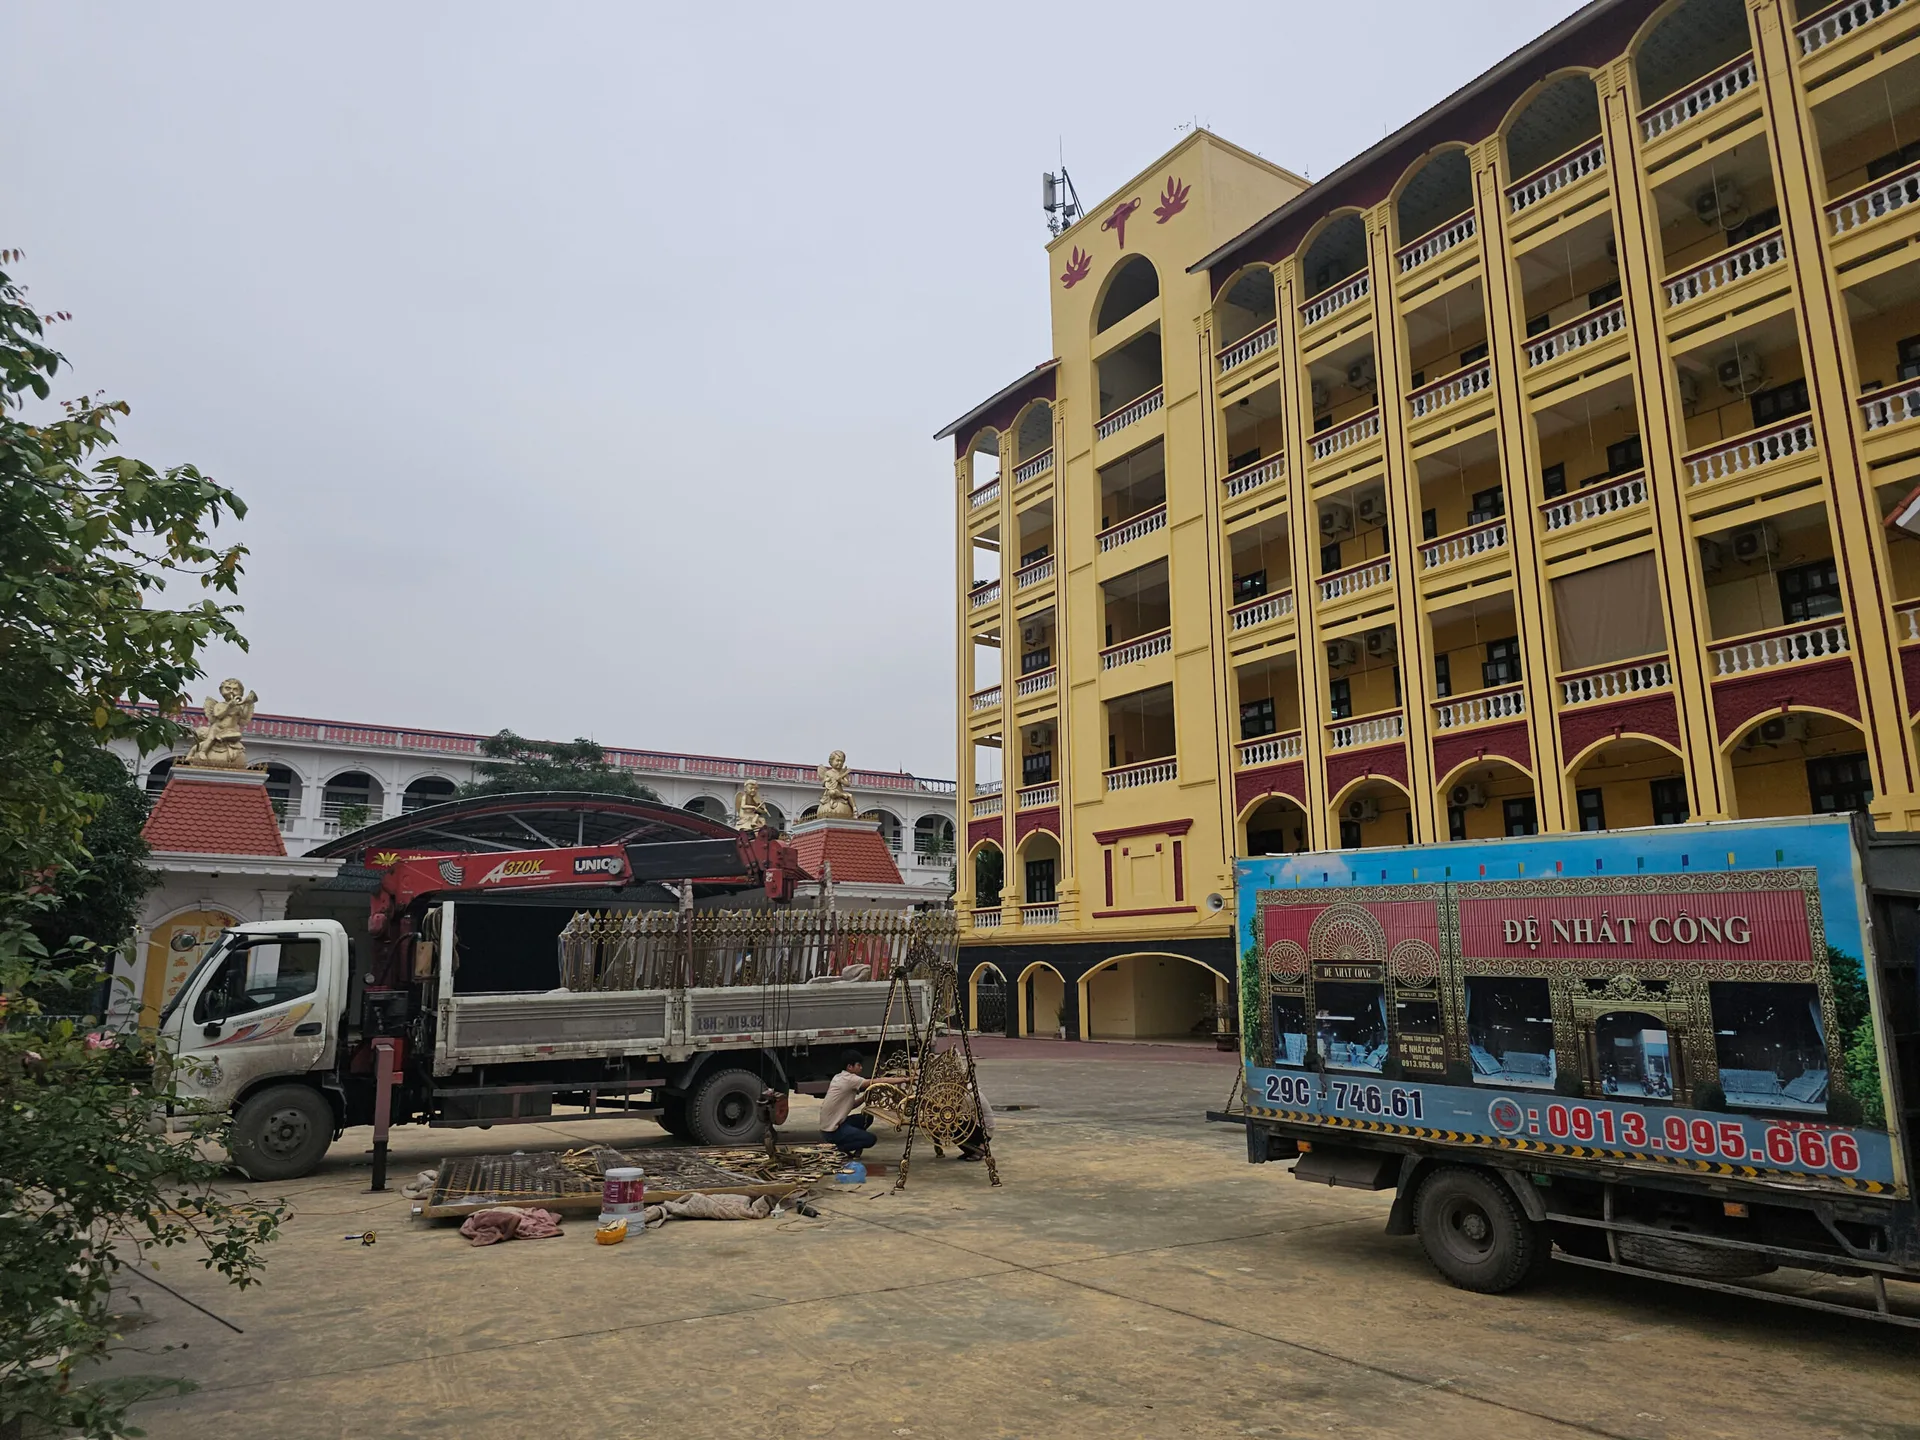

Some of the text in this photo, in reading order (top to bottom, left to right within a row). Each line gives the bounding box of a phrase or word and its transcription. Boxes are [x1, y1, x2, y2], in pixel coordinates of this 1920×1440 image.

[1502, 915, 1542, 950] ĐỆ
[1550, 910, 1636, 944] NHẤT
[1401, 1060, 1444, 1070] 0913.995.666
[1266, 1074, 1311, 1107] 29C
[1332, 1082, 1424, 1120] 746.61
[1547, 1103, 1861, 1174] 0913.995.666
